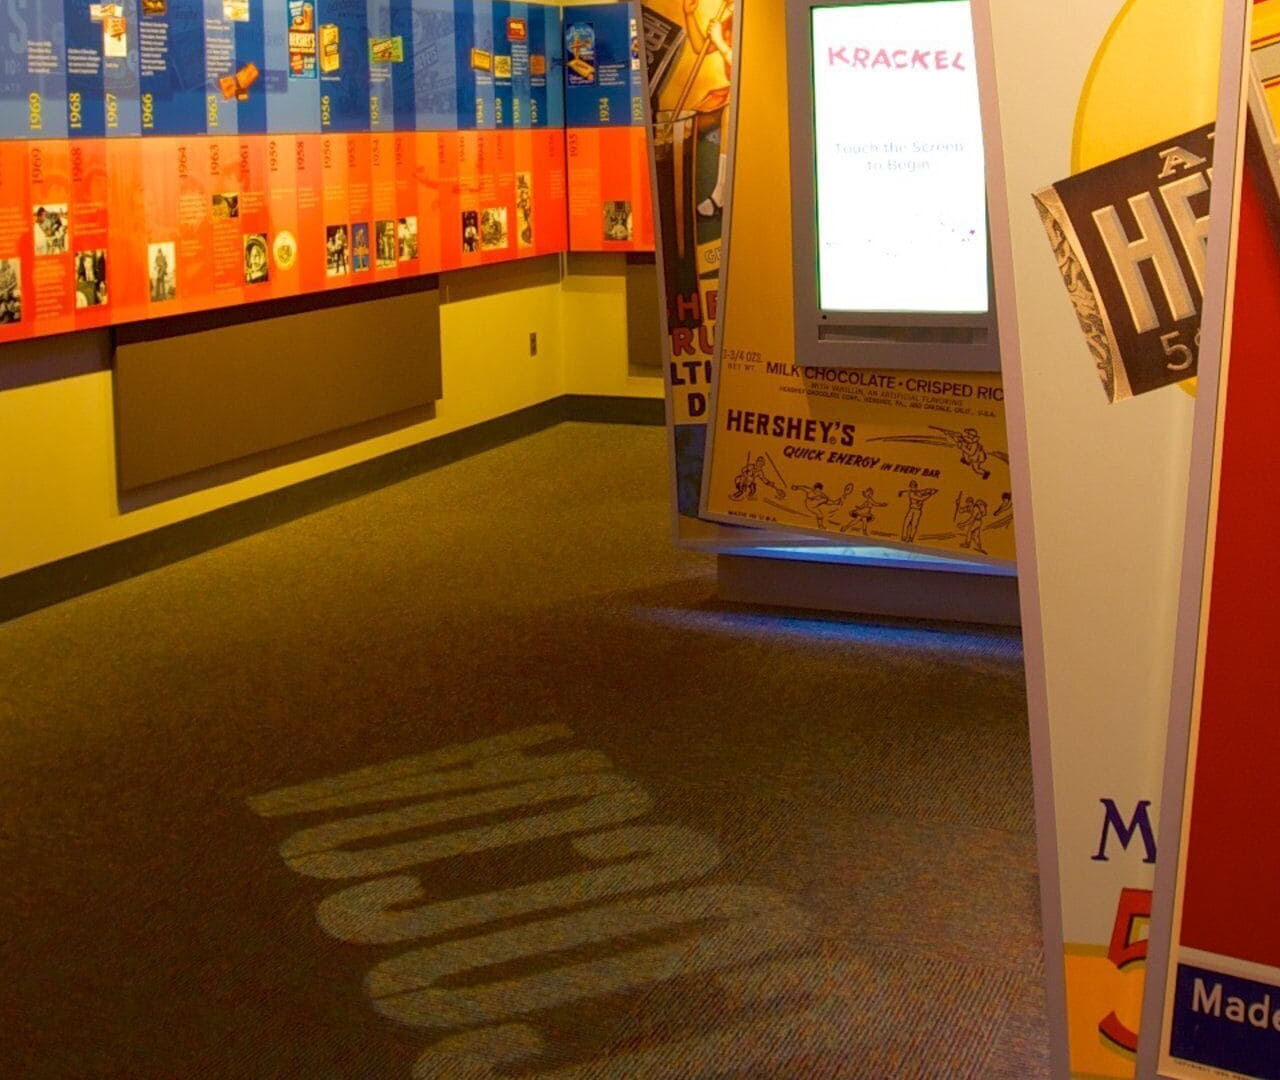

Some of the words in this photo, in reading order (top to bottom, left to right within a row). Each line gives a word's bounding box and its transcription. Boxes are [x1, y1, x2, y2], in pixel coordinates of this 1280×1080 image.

[827, 46, 966, 70] KRACKEL
[28, 92, 42, 130] 1969
[69, 92, 82, 129] 1968
[106, 92, 119, 129] 1967
[141, 92, 154, 129] 1966
[835, 142, 878, 154] Touch
[912, 141, 965, 153] Screen
[766, 362, 801, 378] MILK
[803, 366, 896, 390] CHOCOLATE
[905, 378, 973, 397] CRISPED
[726, 409, 856, 447] HERSHEY'S
[783, 445, 825, 463] QUICK
[827, 451, 880, 469] ENERGY
[881, 463, 892, 471] IN
[893, 464, 920, 477] EVERY
[921, 468, 941, 480] BAR
